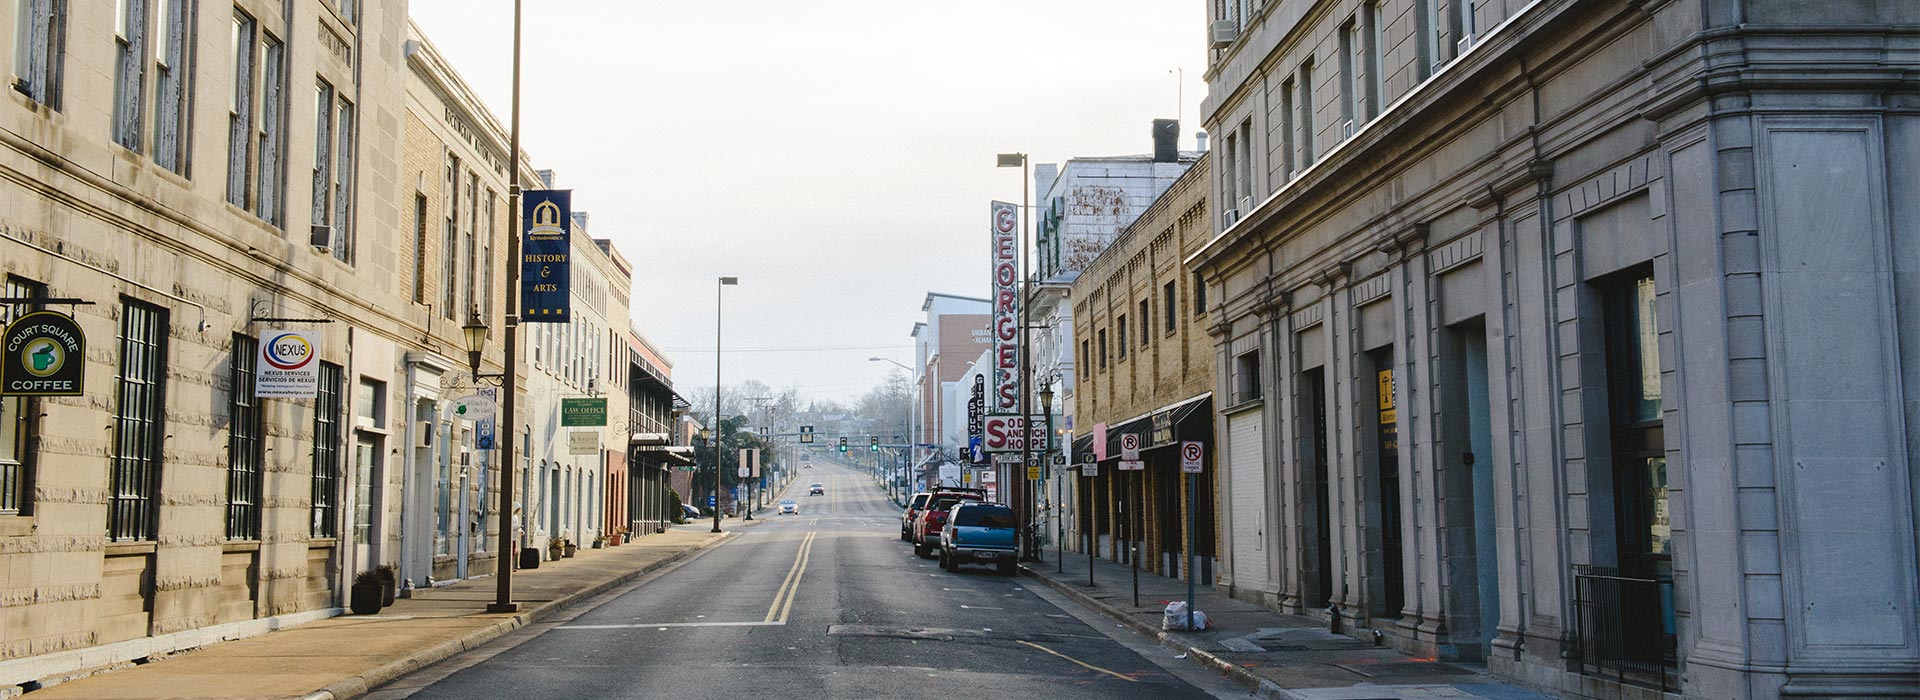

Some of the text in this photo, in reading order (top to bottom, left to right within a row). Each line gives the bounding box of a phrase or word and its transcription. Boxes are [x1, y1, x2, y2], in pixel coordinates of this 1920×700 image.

[525, 254, 567, 263] HISTORY
[541, 265, 551, 278] &
[533, 284, 557, 293] ARTS
[996, 208, 1016, 409] GEORGE'S
[8, 324, 79, 353] COURT SQUARE
[275, 344, 306, 356] NEXUS
[11, 380, 72, 390] COFFEE
[1006, 428, 1047, 438] ANDICH
[1007, 439, 1047, 449] HOPE
